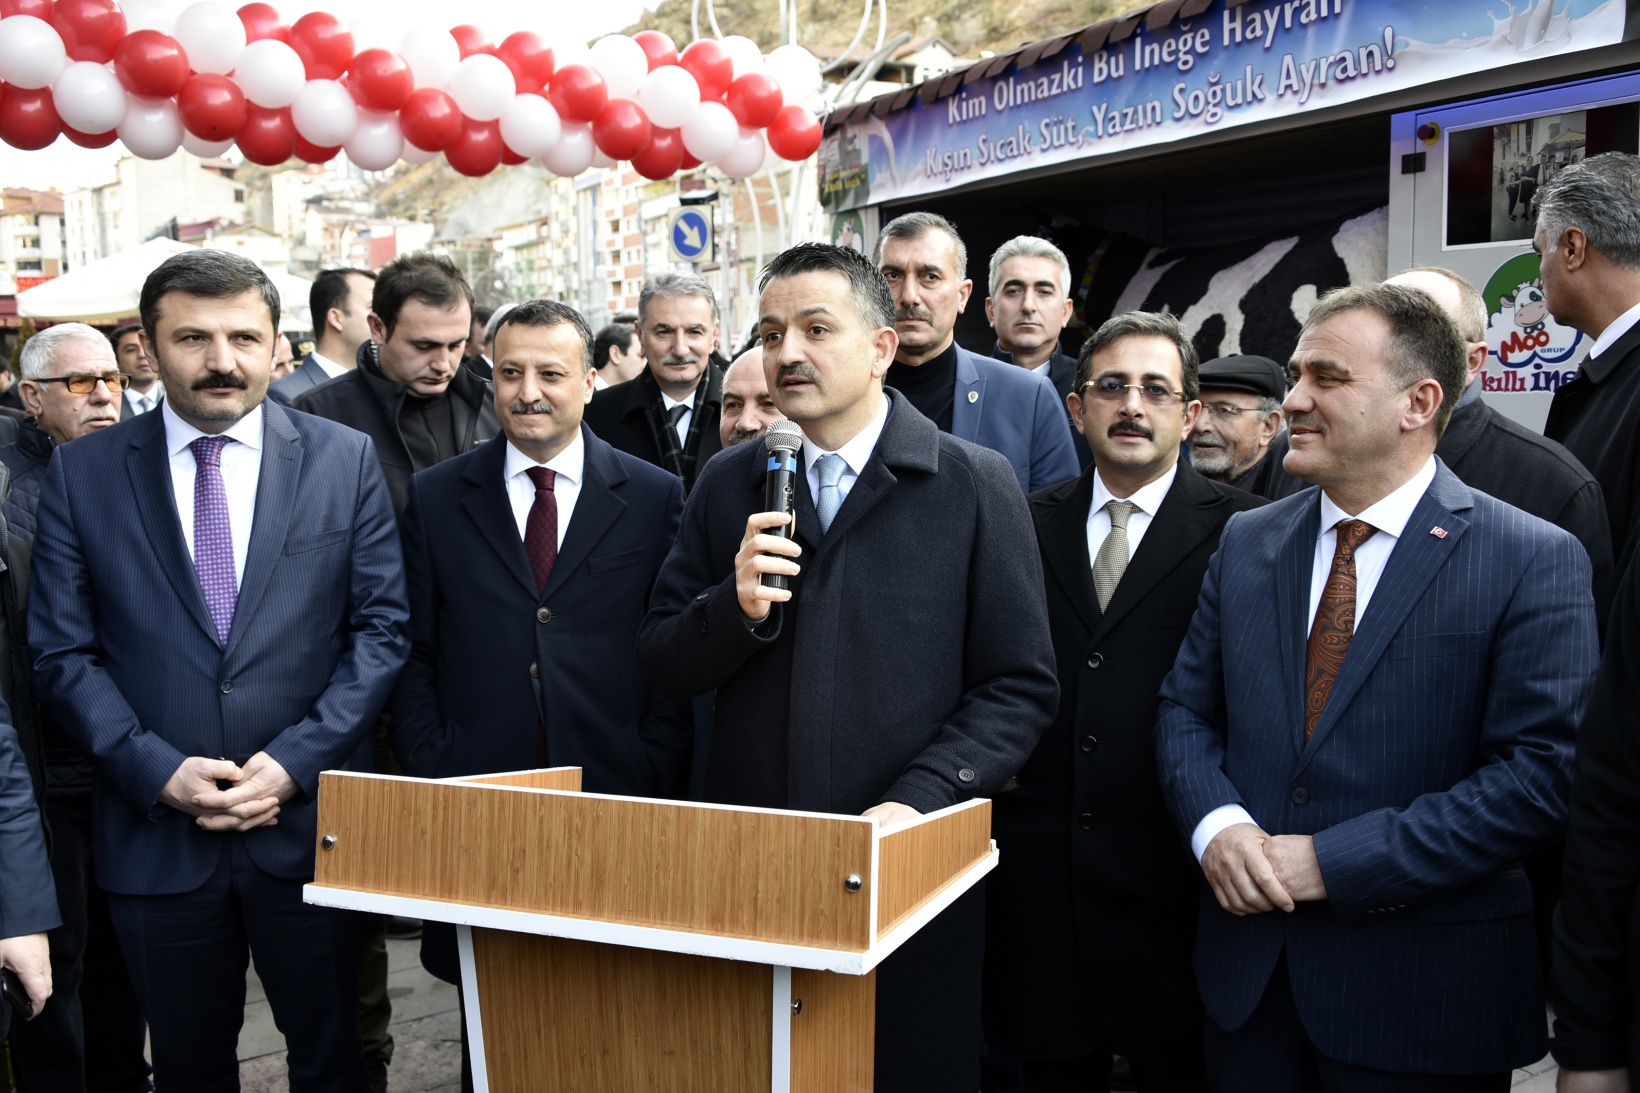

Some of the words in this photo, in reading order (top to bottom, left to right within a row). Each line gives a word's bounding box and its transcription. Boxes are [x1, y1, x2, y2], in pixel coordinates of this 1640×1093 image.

[926, 147, 972, 180] Kışın
[978, 125, 1032, 165] Sıcak
[1039, 115, 1084, 150] Süt,
[1092, 100, 1162, 137] Yazın
[1173, 65, 1266, 123] Soğuk
[1278, 26, 1396, 104] Ayran!
[948, 92, 986, 124] Kim
[993, 55, 1083, 111] Olmazki
[1093, 51, 1125, 84] Bu
[1134, 21, 1210, 71] İneğe
[1481, 370, 1527, 392] kıllı
